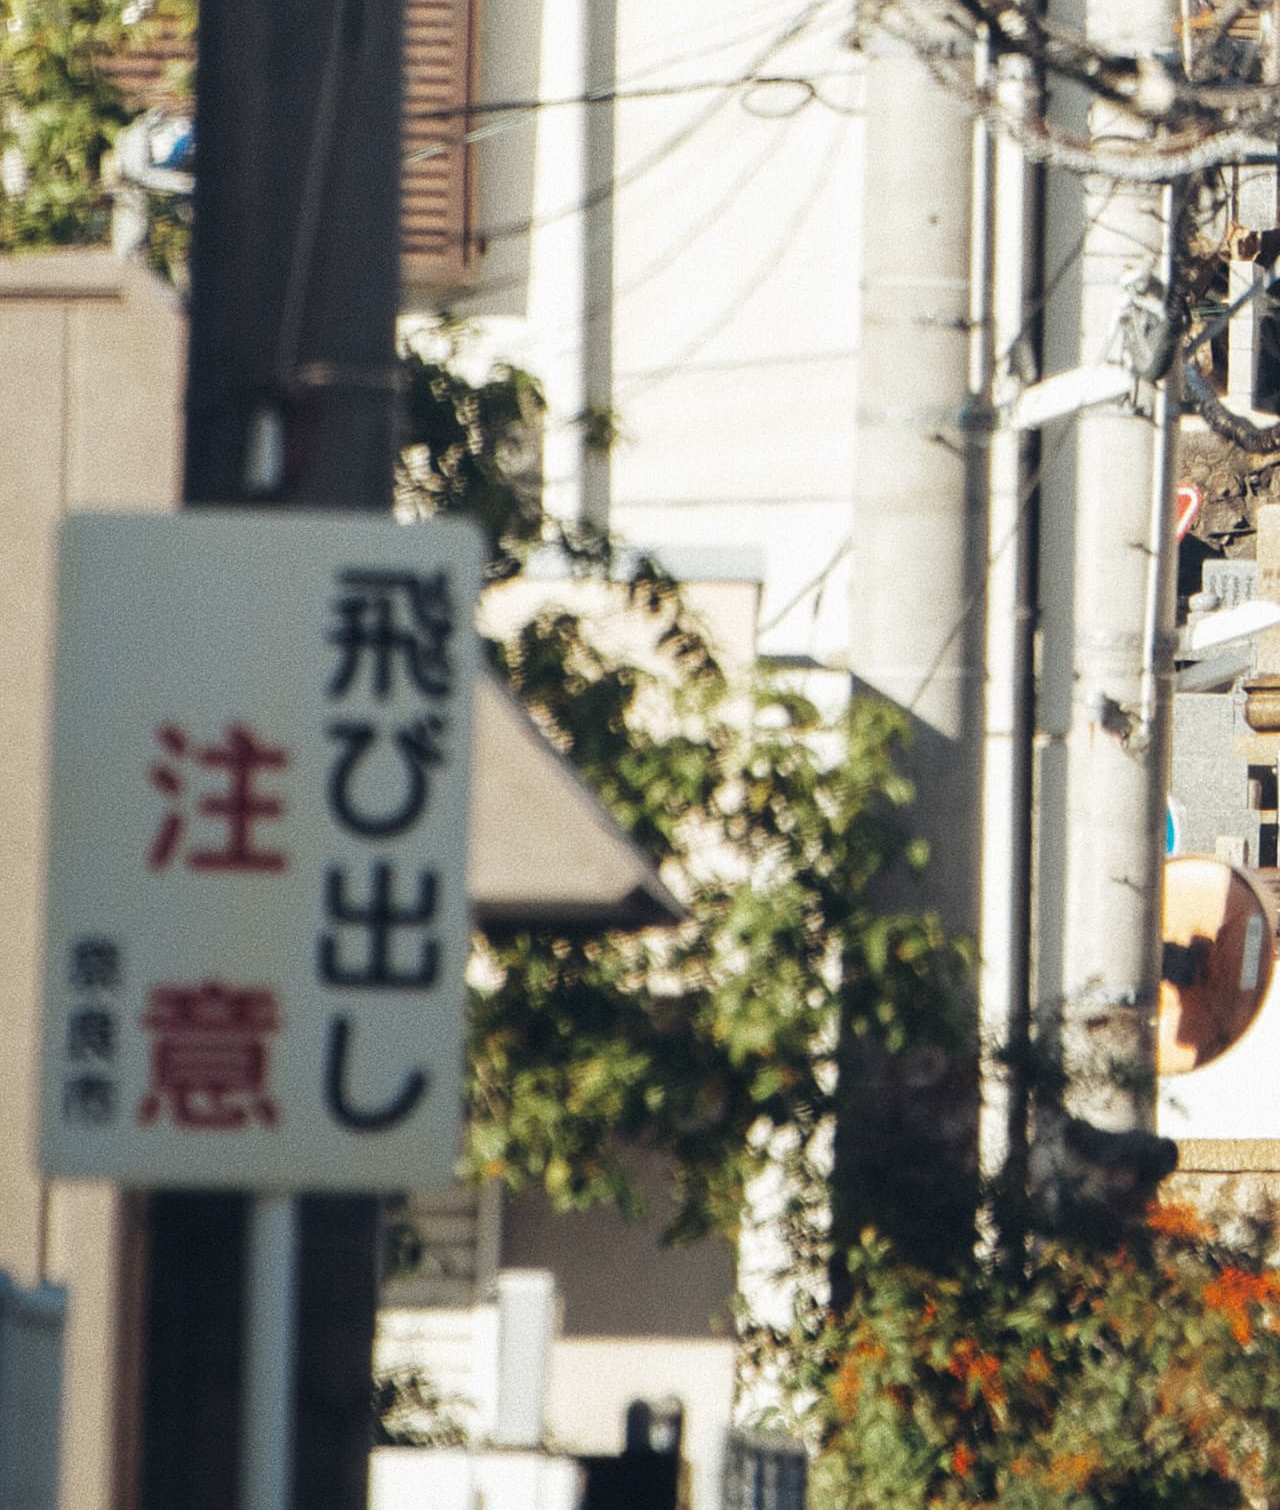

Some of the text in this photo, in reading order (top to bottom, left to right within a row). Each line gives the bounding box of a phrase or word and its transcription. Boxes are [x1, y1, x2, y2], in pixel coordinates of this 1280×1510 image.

[137, 722, 288, 1130] 注意
[319, 568, 453, 1131] 飛び出し
